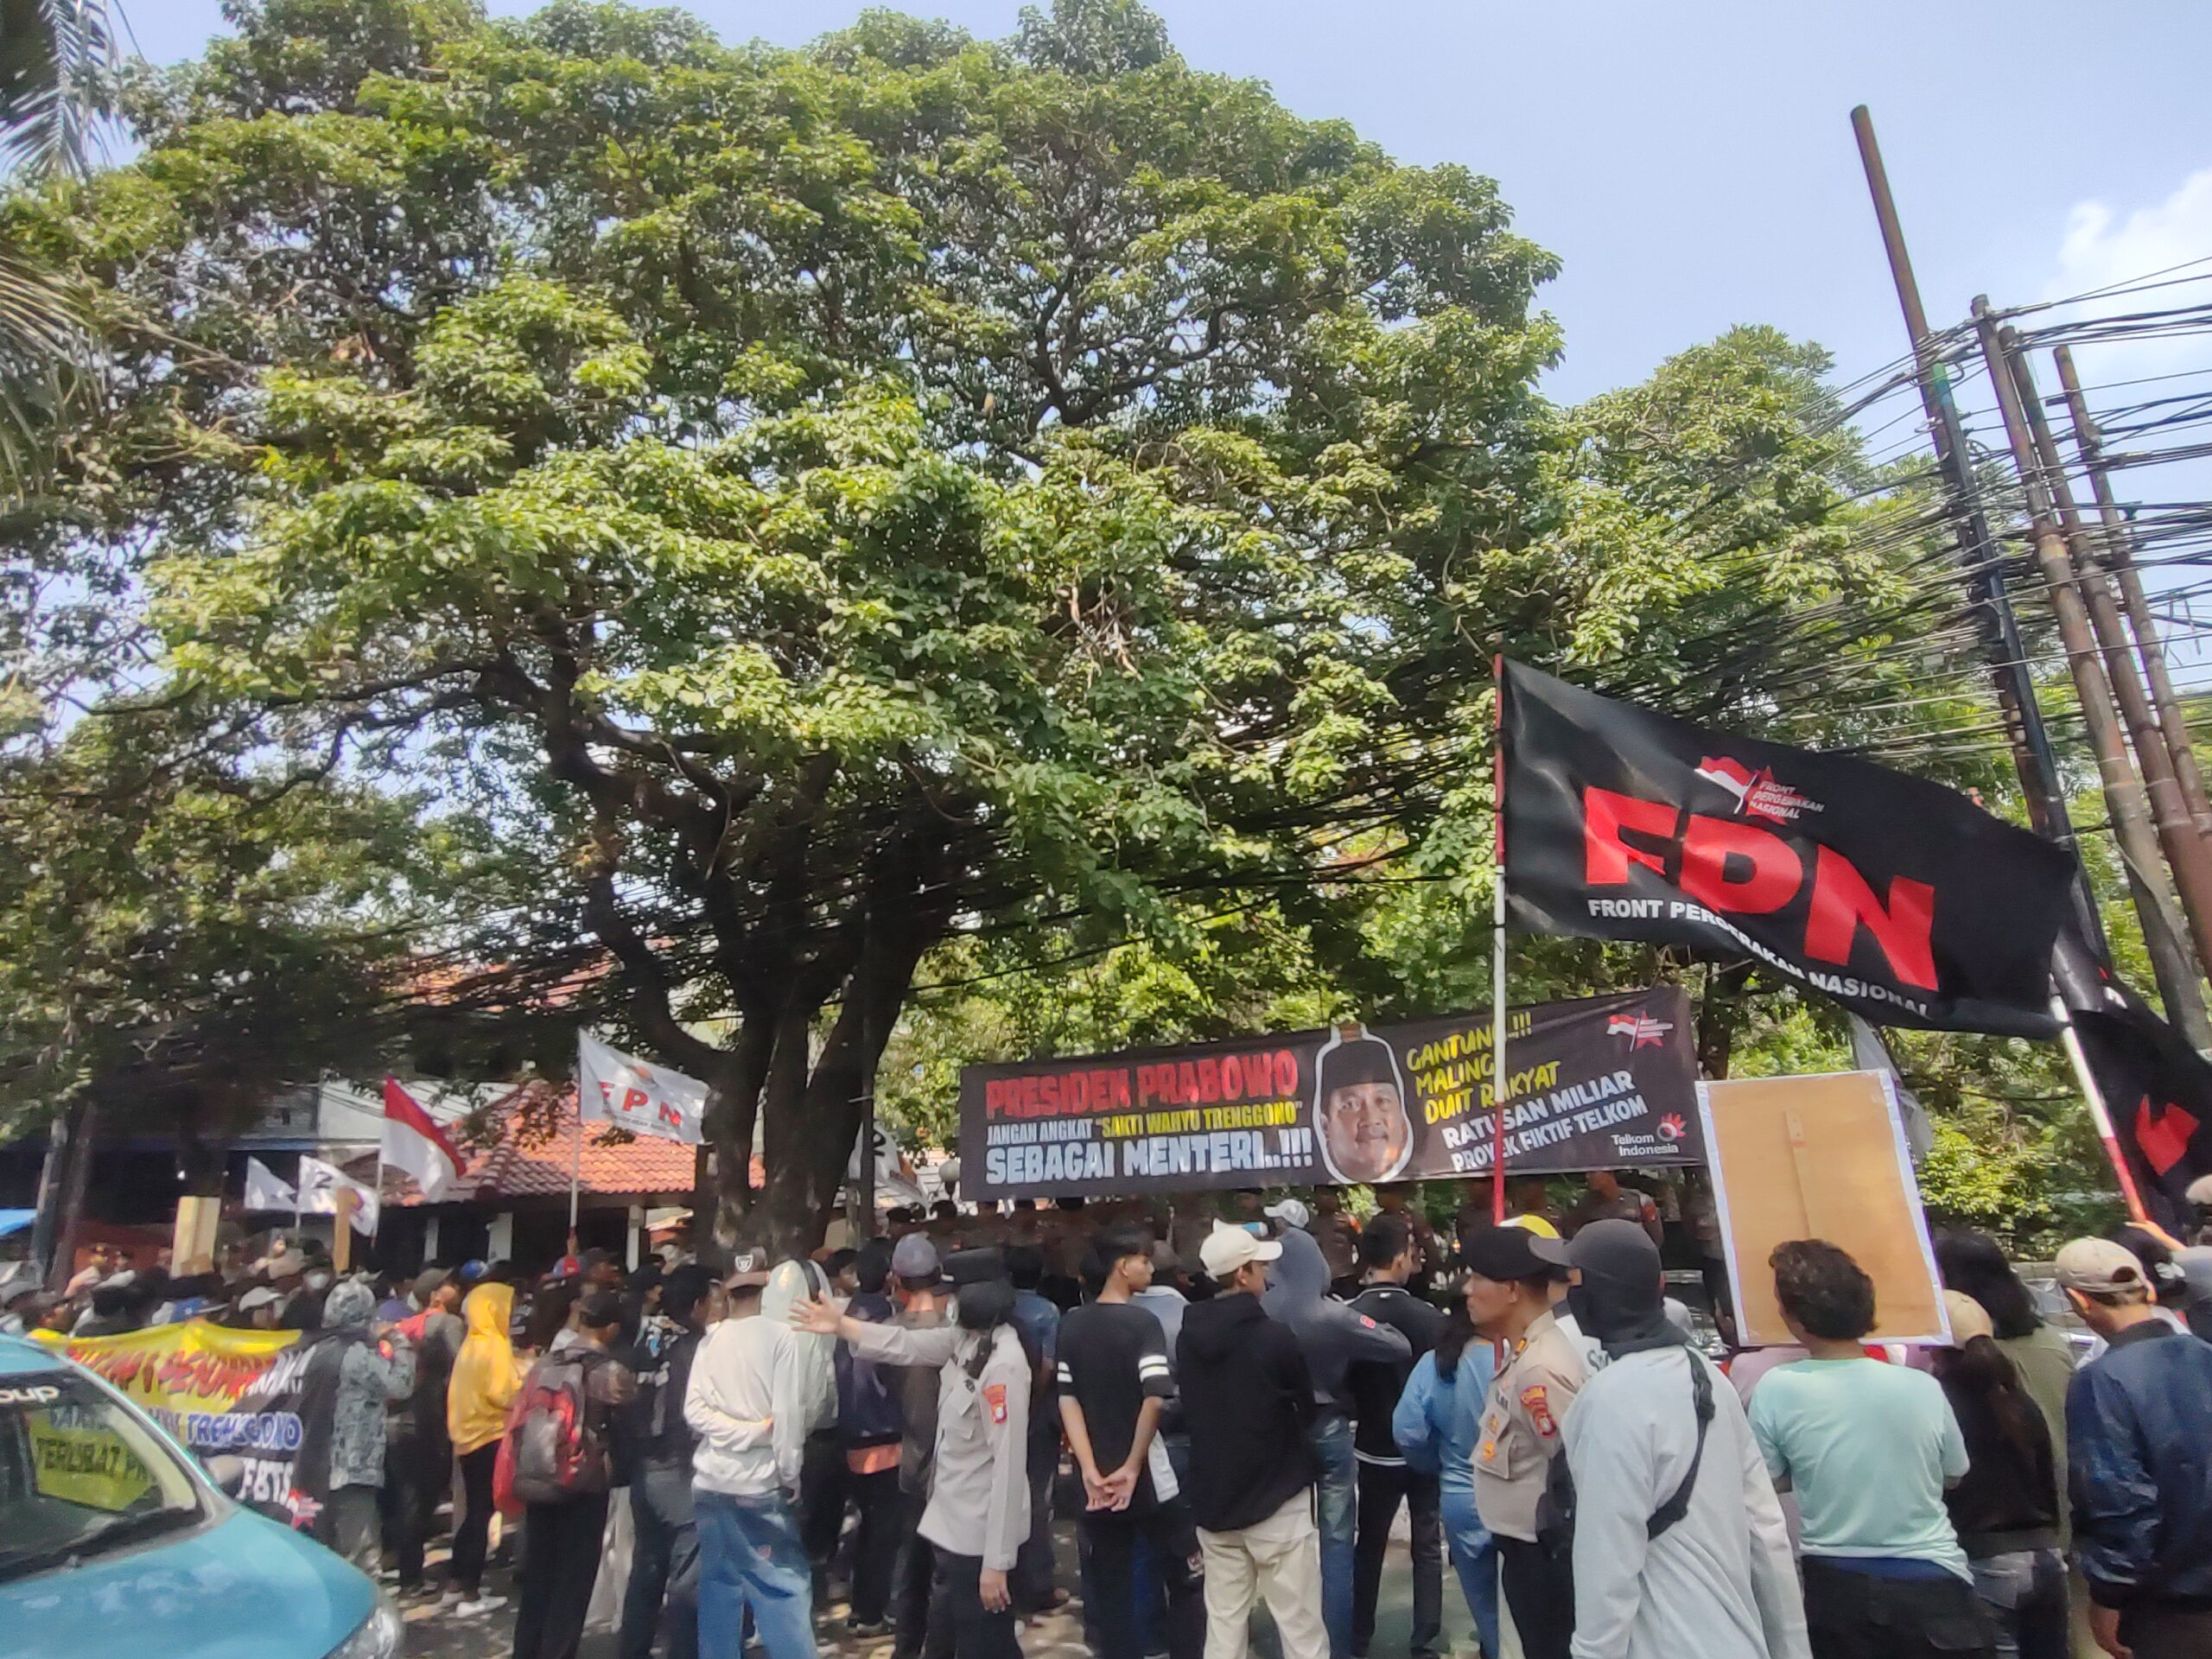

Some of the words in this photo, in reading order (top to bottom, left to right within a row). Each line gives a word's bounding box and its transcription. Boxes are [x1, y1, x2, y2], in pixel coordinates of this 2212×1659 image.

[1752, 791, 1825, 812] PERGERAKAN
[1759, 780, 1796, 796] FRONT
[1750, 801, 1800, 819] NASIONAL
[1587, 899, 1663, 918] FRONT
[1670, 901, 1806, 979] PERGERAKAN
[1808, 971, 1934, 1021] NASIONAL
[986, 1068, 1131, 1120] PRESIDEN
[1136, 1049, 1298, 1108] PRABOWO
[1415, 1052, 1495, 1097] MALING
[1425, 1087, 1473, 1125] DUIT
[1442, 1096, 1549, 1149] RATUSAN
[1549, 1070, 1636, 1115] MILIAR
[1518, 1118, 1575, 1151] FIKTIF
[1573, 1094, 1649, 1135] TELKOM
[987, 1122, 1038, 1146] JANGAN
[1039, 1118, 1093, 1142] ANGKAT
[1146, 1109, 1200, 1134] WAHYU
[1611, 1134, 1655, 1146] Telkom
[986, 1141, 1116, 1185] SEBAGAI
[1618, 1142, 1679, 1157] Indonesia
